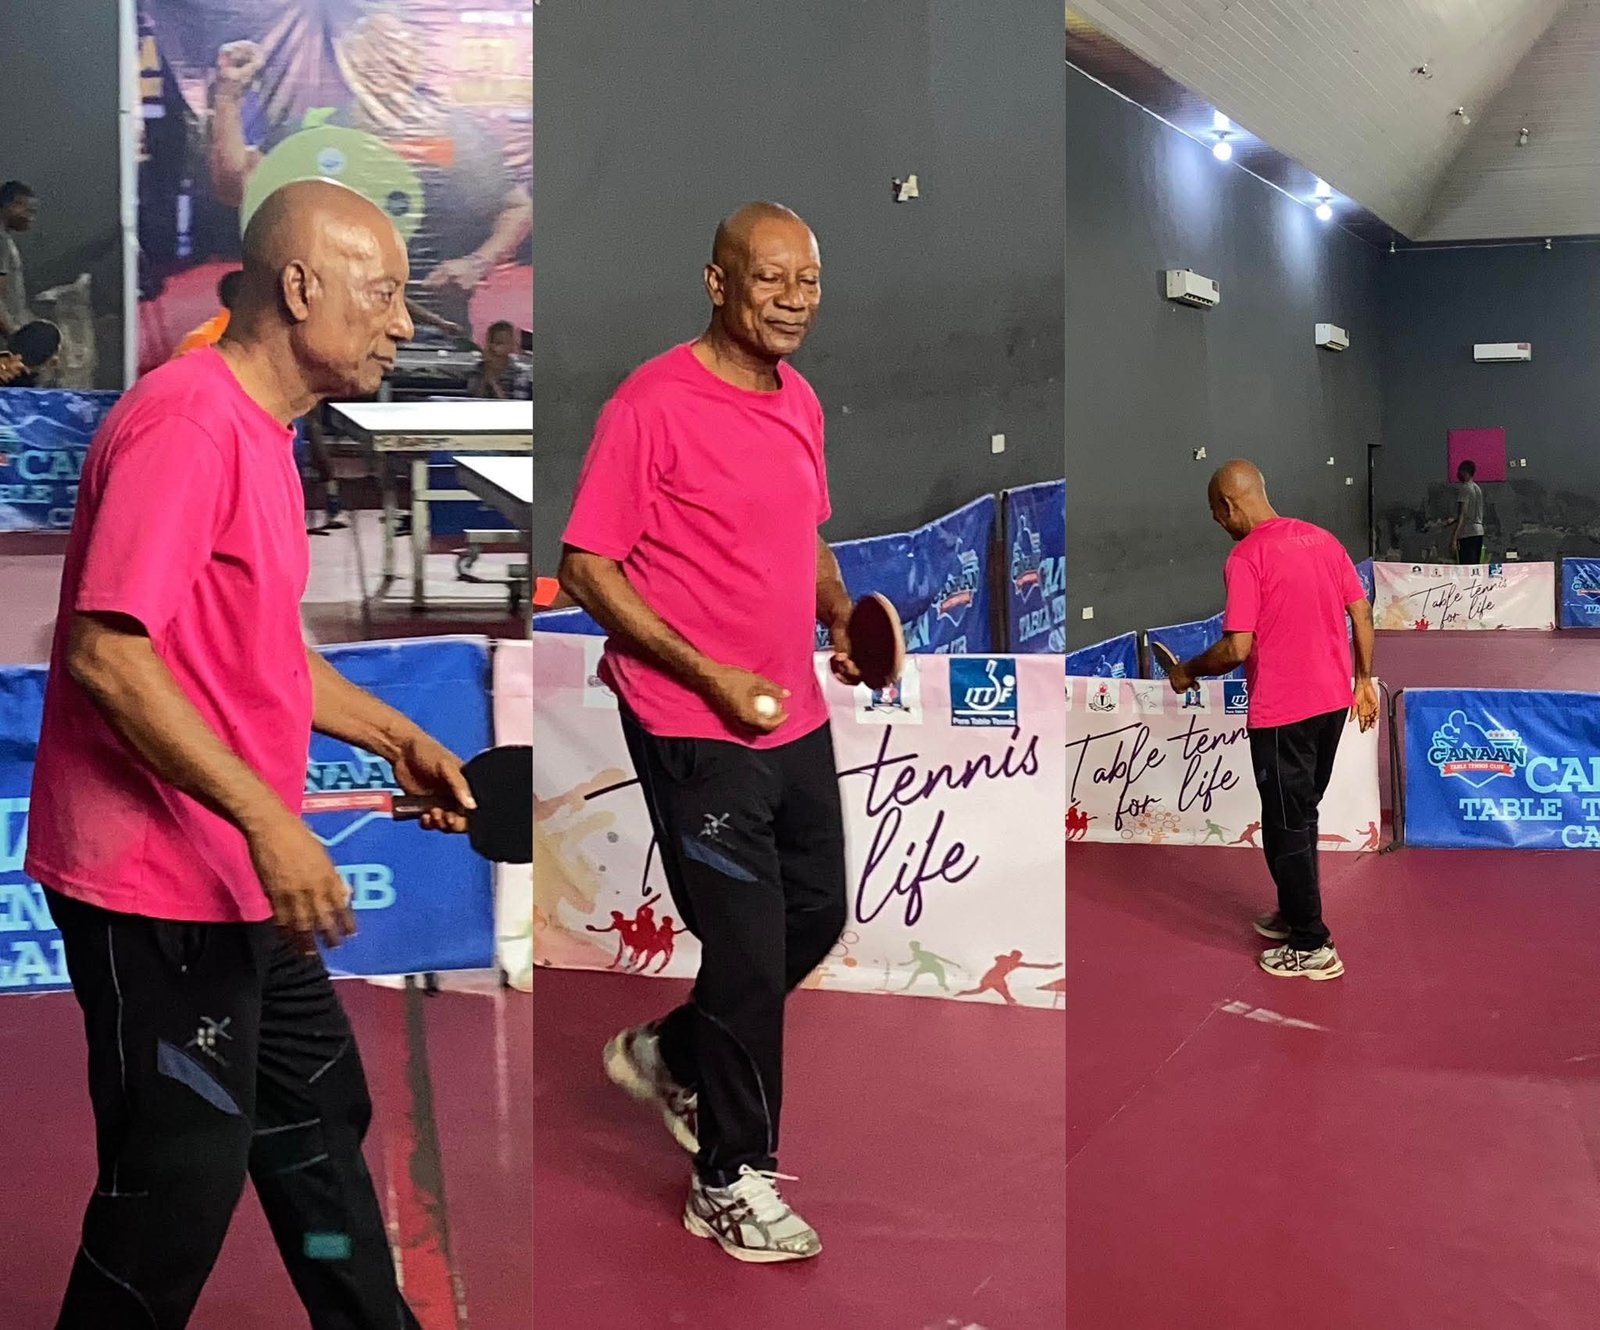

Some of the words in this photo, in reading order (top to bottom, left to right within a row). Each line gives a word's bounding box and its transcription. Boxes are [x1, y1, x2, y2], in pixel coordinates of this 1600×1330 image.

[1410, 582, 1463, 617] Table
[1463, 579, 1508, 599] tennis
[1469, 595, 1496, 620] life
[838, 724, 1039, 817] tennis
[1065, 721, 1167, 803] Table
[1428, 746, 1526, 767] CANAAN
[1115, 778, 1161, 831] for
[1178, 754, 1240, 813] life
[1459, 798, 1562, 822] TABLE
[855, 807, 980, 927] life
